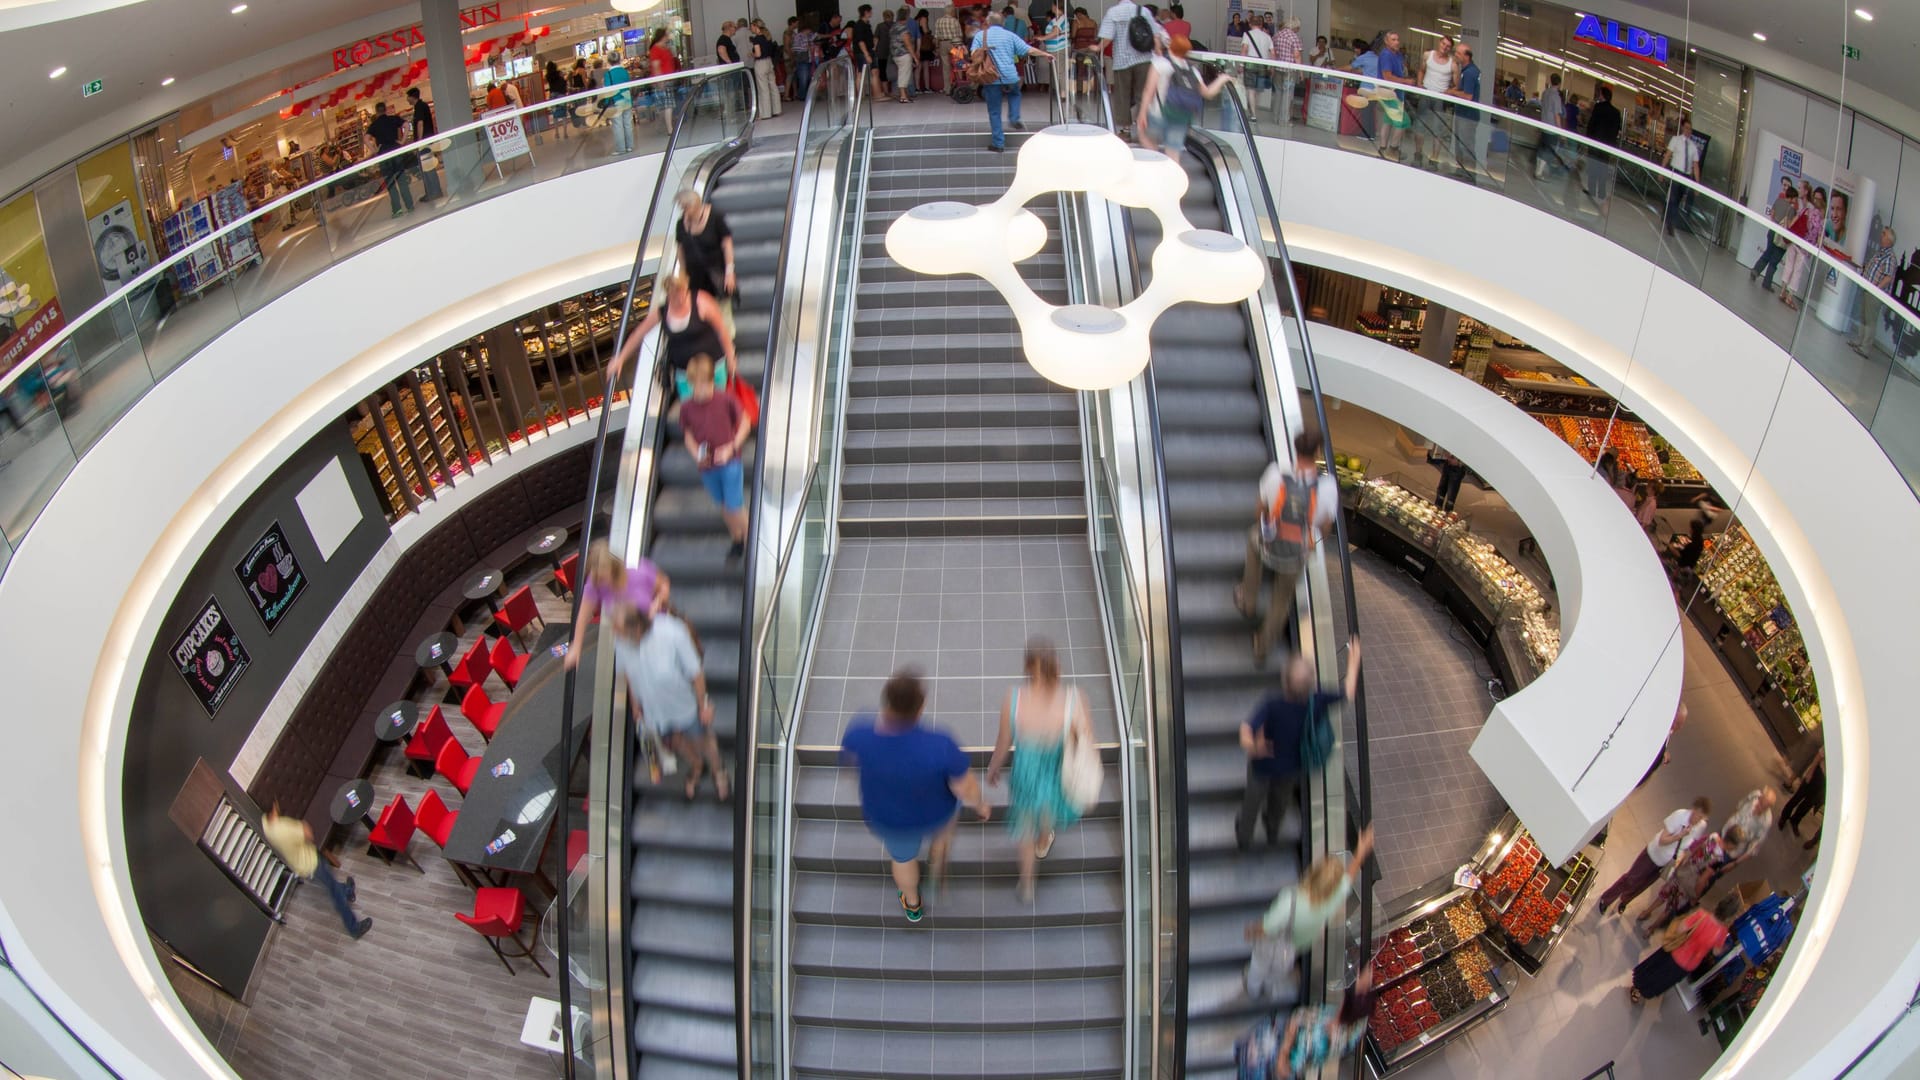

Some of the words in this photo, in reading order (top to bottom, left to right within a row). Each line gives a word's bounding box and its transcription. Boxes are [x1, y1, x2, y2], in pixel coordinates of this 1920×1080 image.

[1574, 13, 1668, 63] ALDI
[490, 119, 519, 138] 10%
[1783, 149, 1803, 162] ALDI
[27, 306, 58, 341] 2015
[249, 581, 268, 608] I
[176, 604, 221, 666] CUPCAKES
